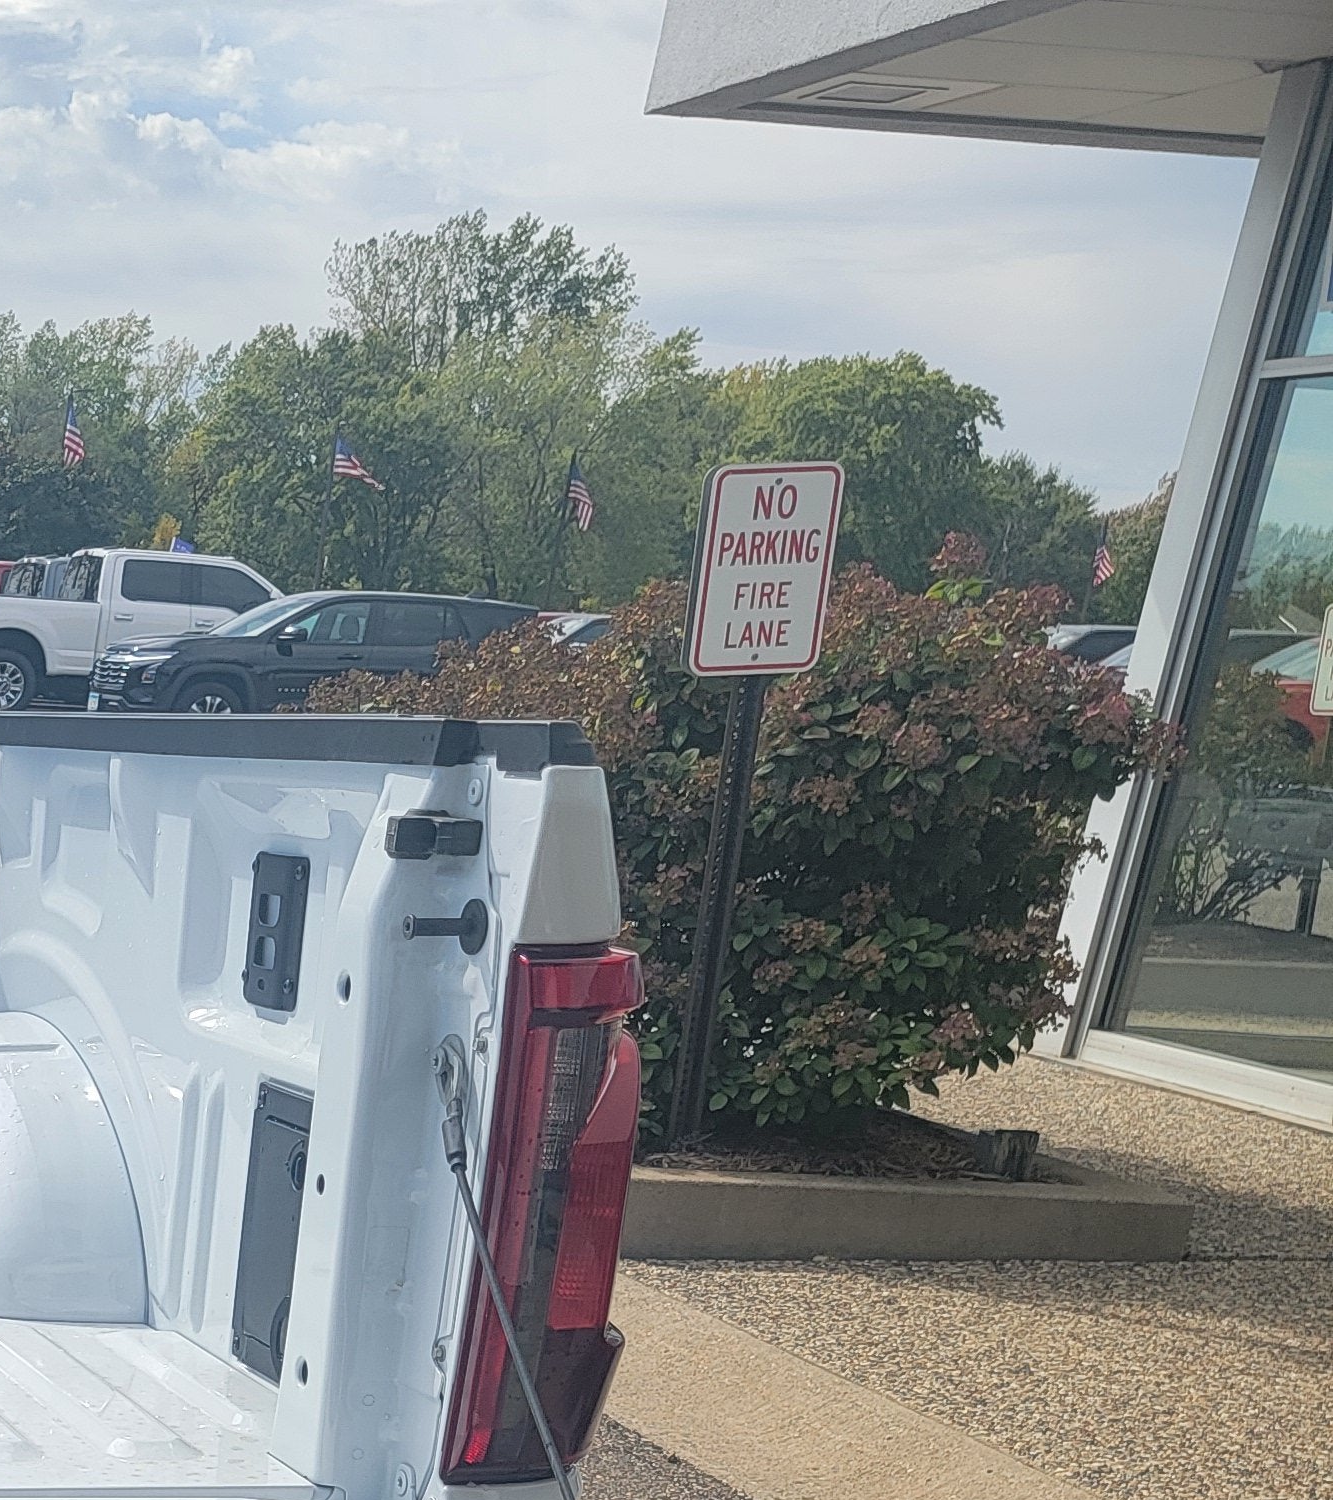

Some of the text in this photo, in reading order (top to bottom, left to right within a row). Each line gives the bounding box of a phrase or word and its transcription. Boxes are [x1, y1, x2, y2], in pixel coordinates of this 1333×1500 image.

[752, 484, 798, 521] NO
[717, 528, 822, 567] PARKING
[733, 580, 793, 610] FIRE
[723, 619, 792, 650] LANE
